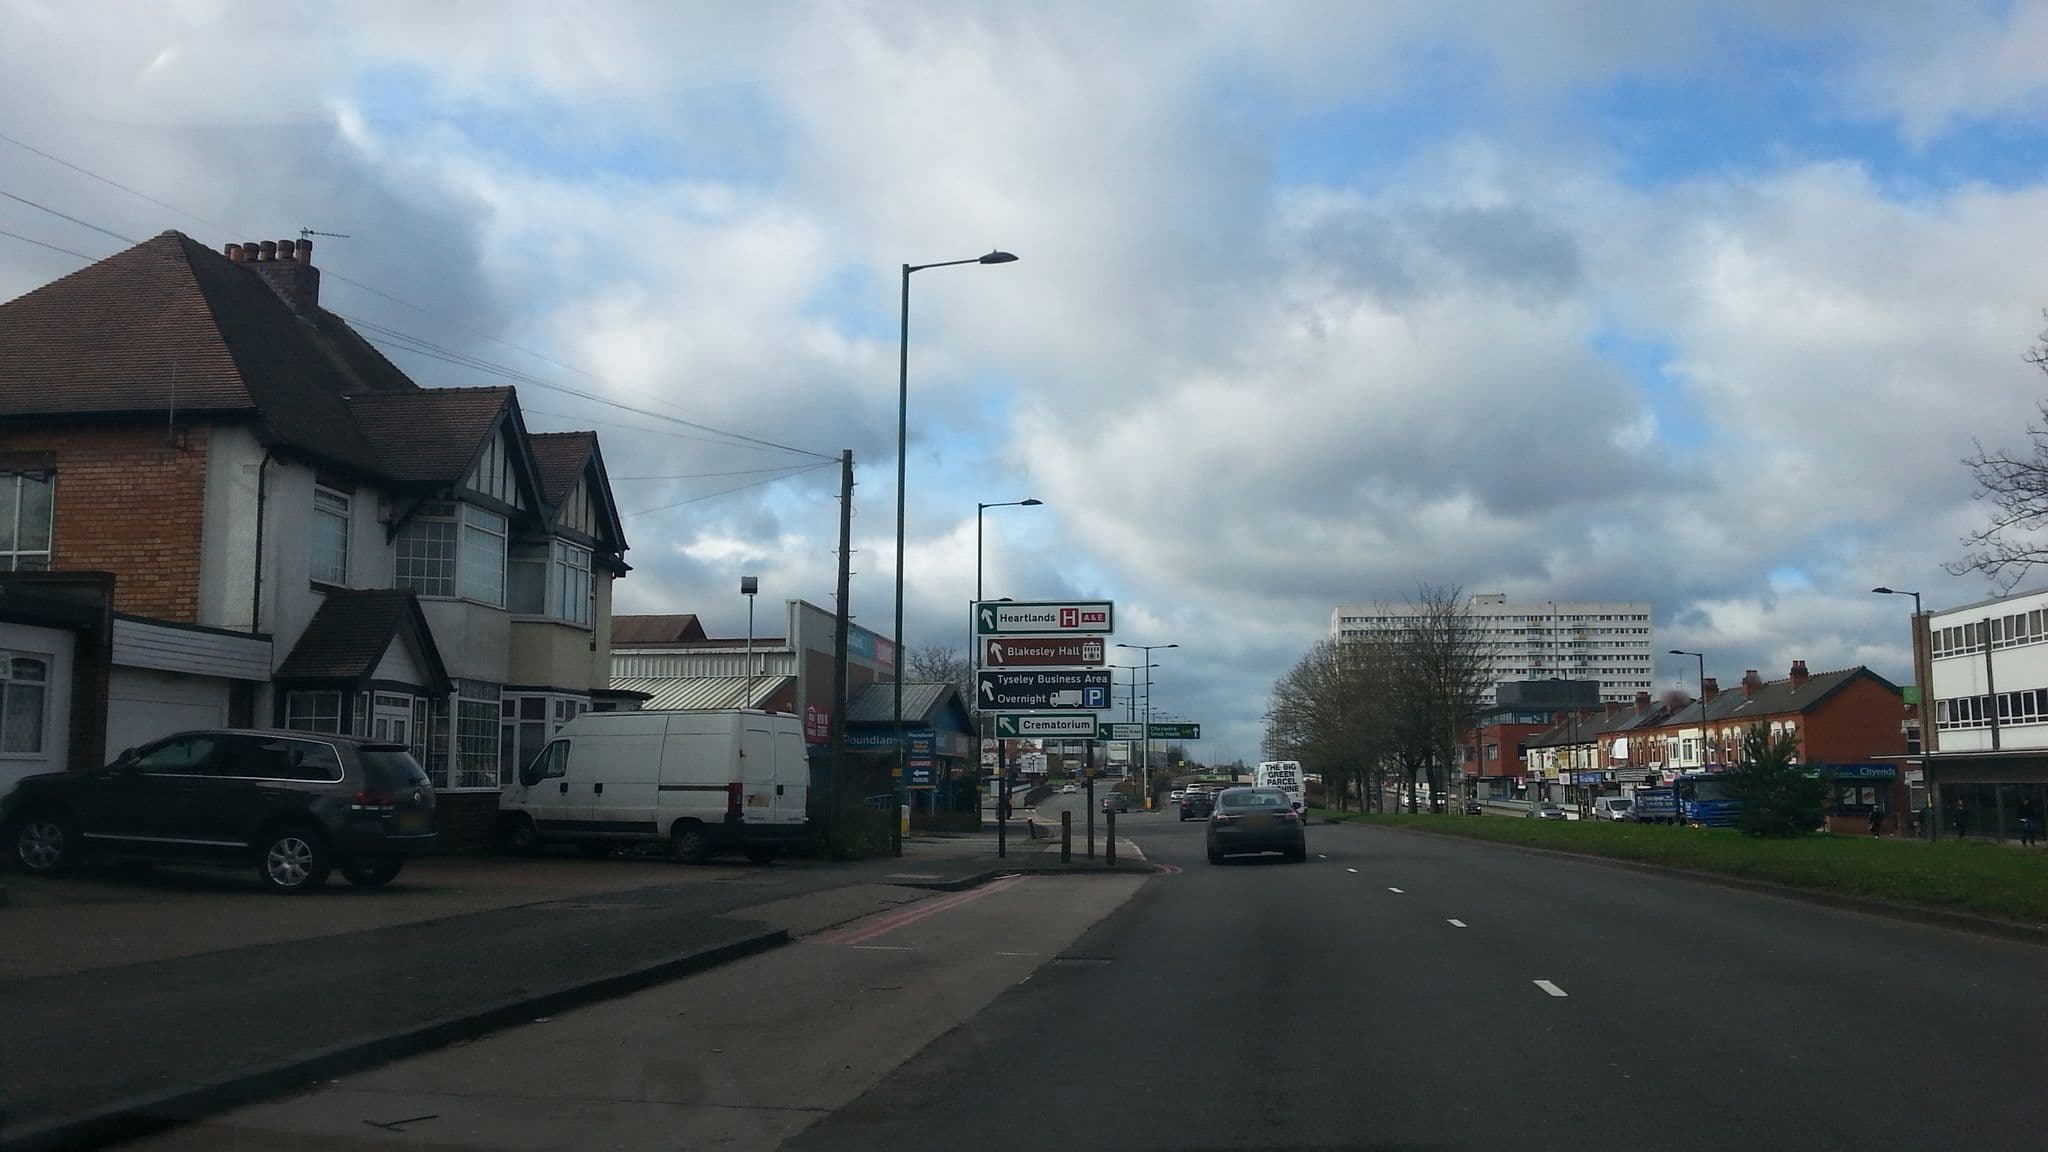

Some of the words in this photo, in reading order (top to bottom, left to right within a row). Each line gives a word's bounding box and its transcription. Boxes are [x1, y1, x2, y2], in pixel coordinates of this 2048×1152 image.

[1000, 612, 1056, 623] Heartlands
[1063, 610, 1077, 626] H
[1083, 613, 1104, 622] A&E
[1007, 646, 1055, 657] Blakesley
[1059, 646, 1080, 656] Hall
[997, 674, 1034, 685] Tyseley
[1038, 674, 1081, 683] Business
[1085, 674, 1108, 683] Area
[997, 693, 1046, 704] Overnight
[1089, 689, 1101, 705] P
[1023, 718, 1090, 729] Crematorium
